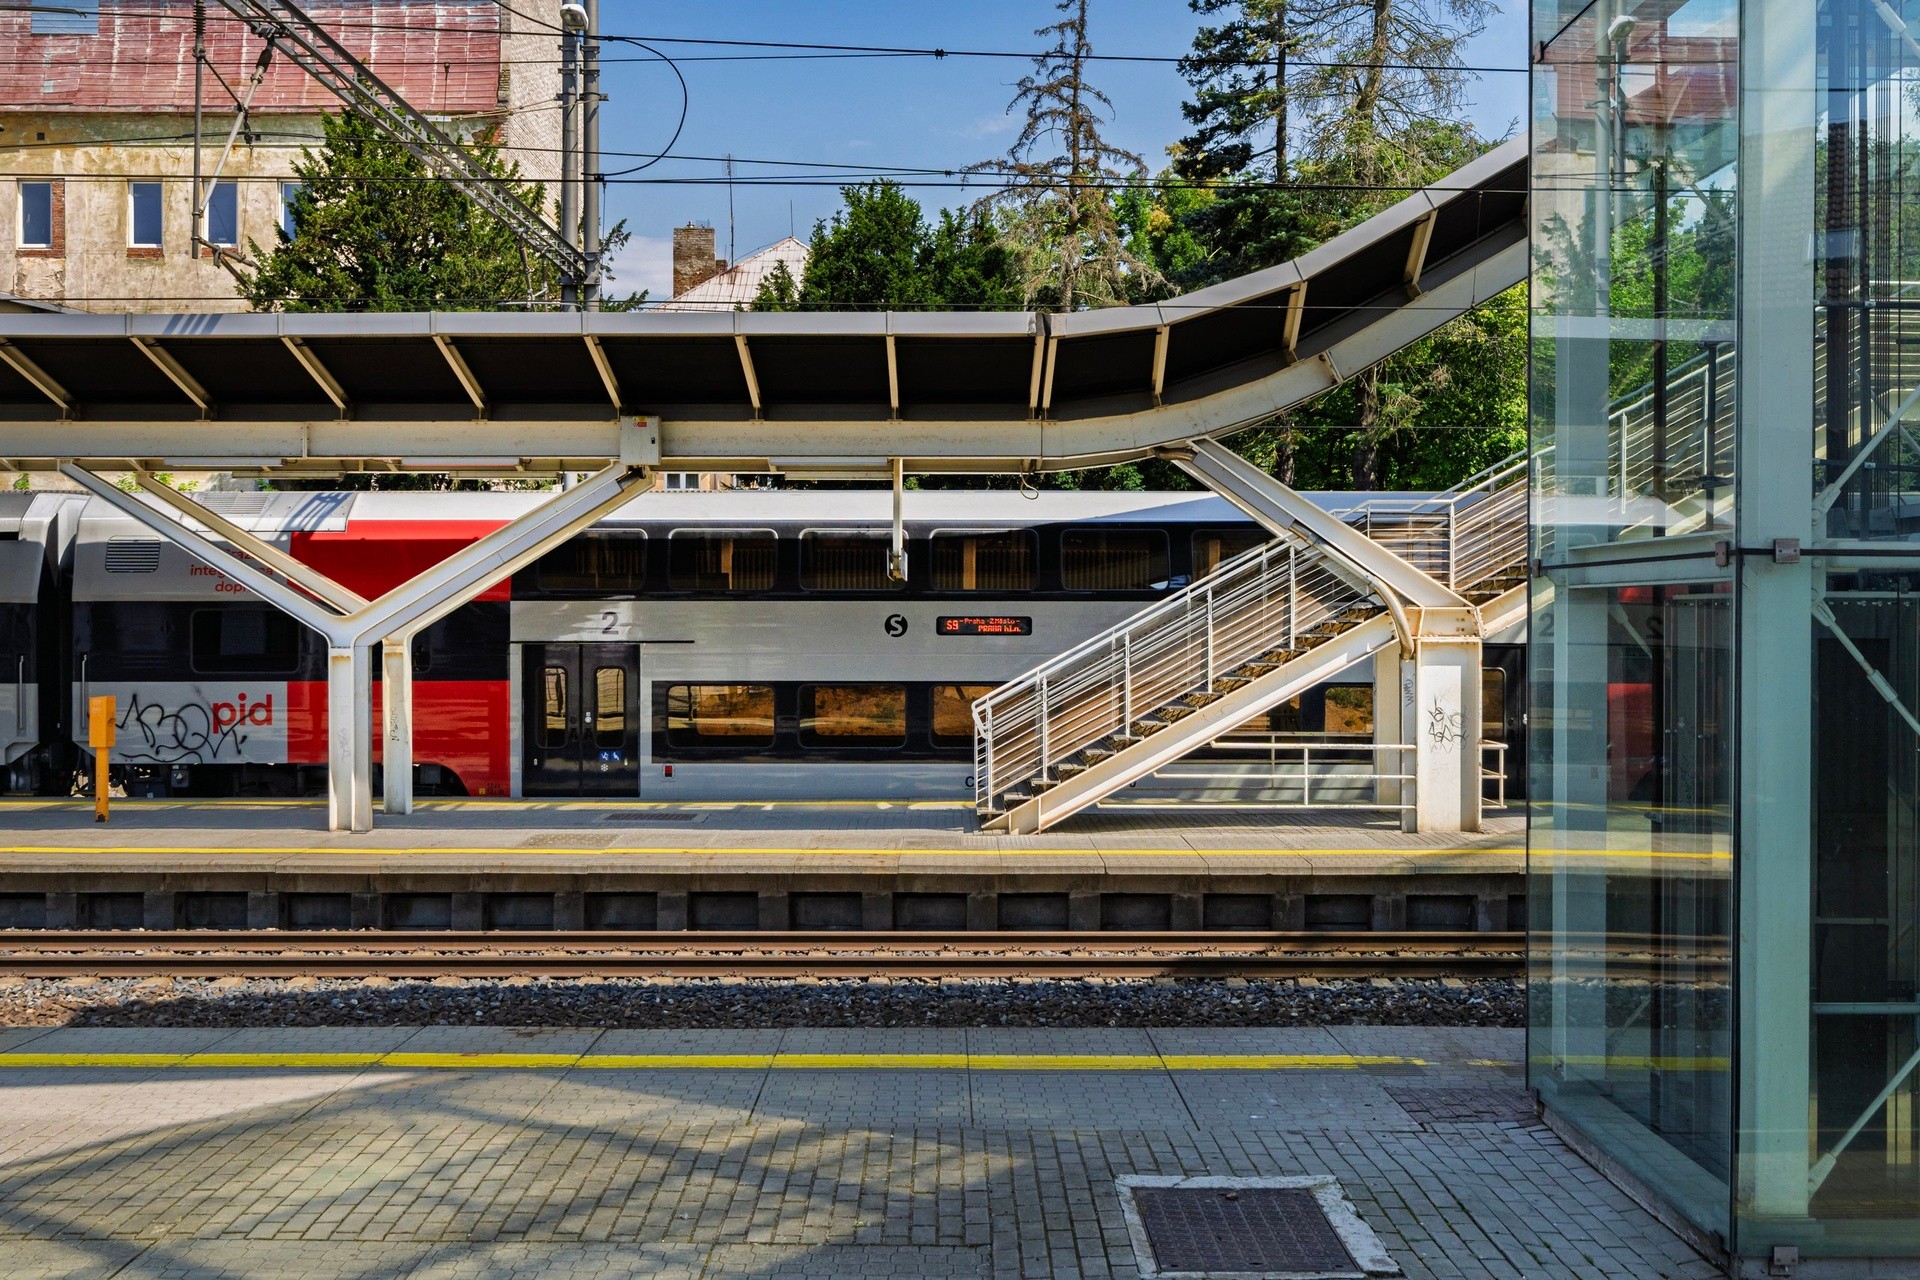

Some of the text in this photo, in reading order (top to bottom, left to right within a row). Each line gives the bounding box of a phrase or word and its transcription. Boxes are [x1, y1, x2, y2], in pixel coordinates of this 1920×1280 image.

[601, 611, 619, 635] 2
[888, 614, 904, 637] S
[946, 619, 959, 631] S9
[978, 624, 1002, 632] PRAHA
[1538, 611, 1554, 637] 2
[212, 692, 273, 734] pid
